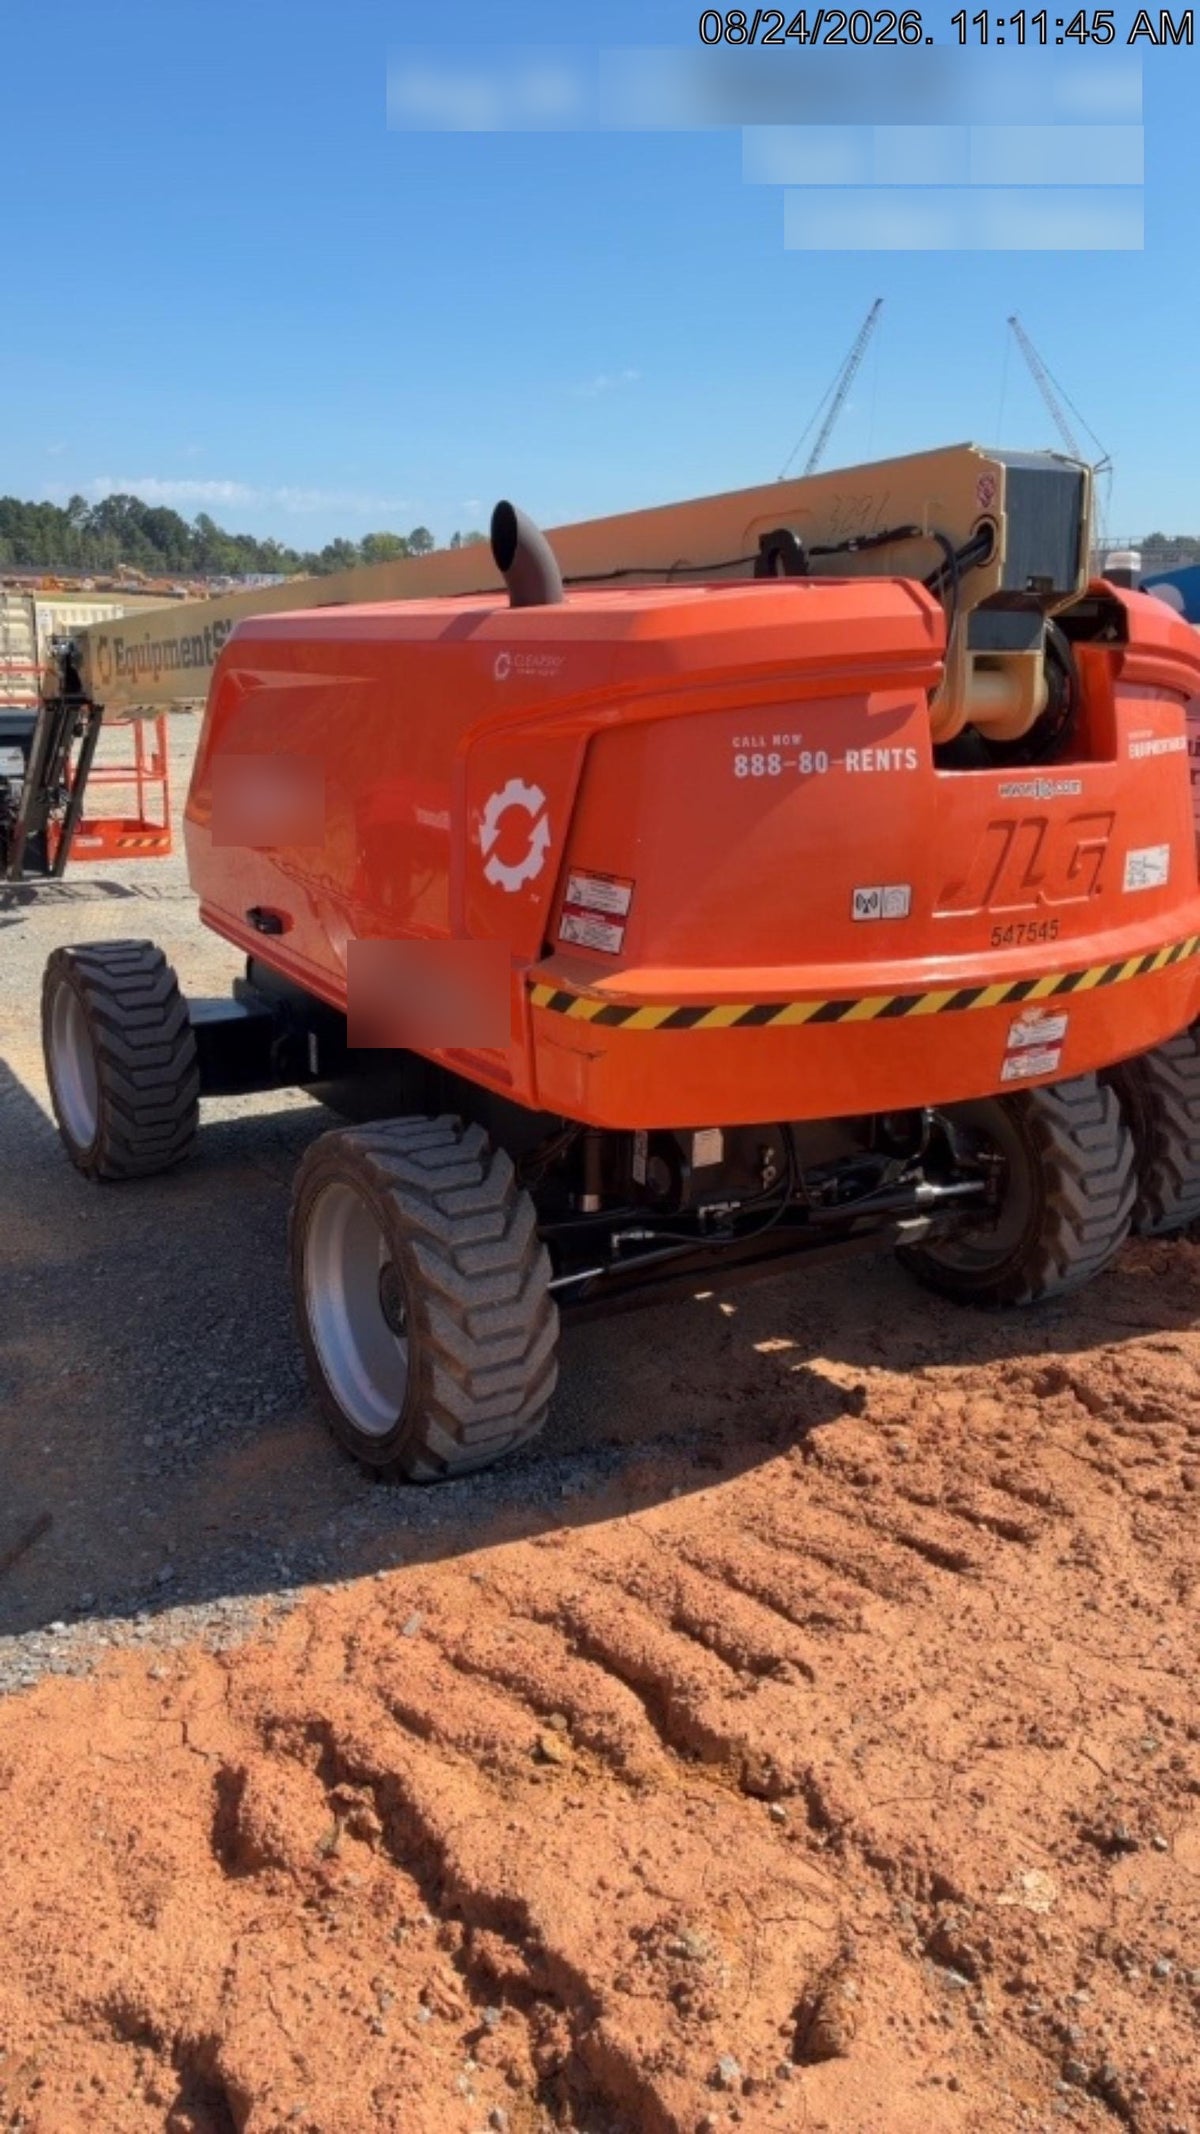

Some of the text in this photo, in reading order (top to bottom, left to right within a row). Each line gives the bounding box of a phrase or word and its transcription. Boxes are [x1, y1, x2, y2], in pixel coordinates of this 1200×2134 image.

[732, 734, 802, 748] CALL NOW
[734, 748, 918, 778] 888-80-RENTS
[932, 811, 1115, 918] JLG
[991, 919, 1060, 947] 547545
